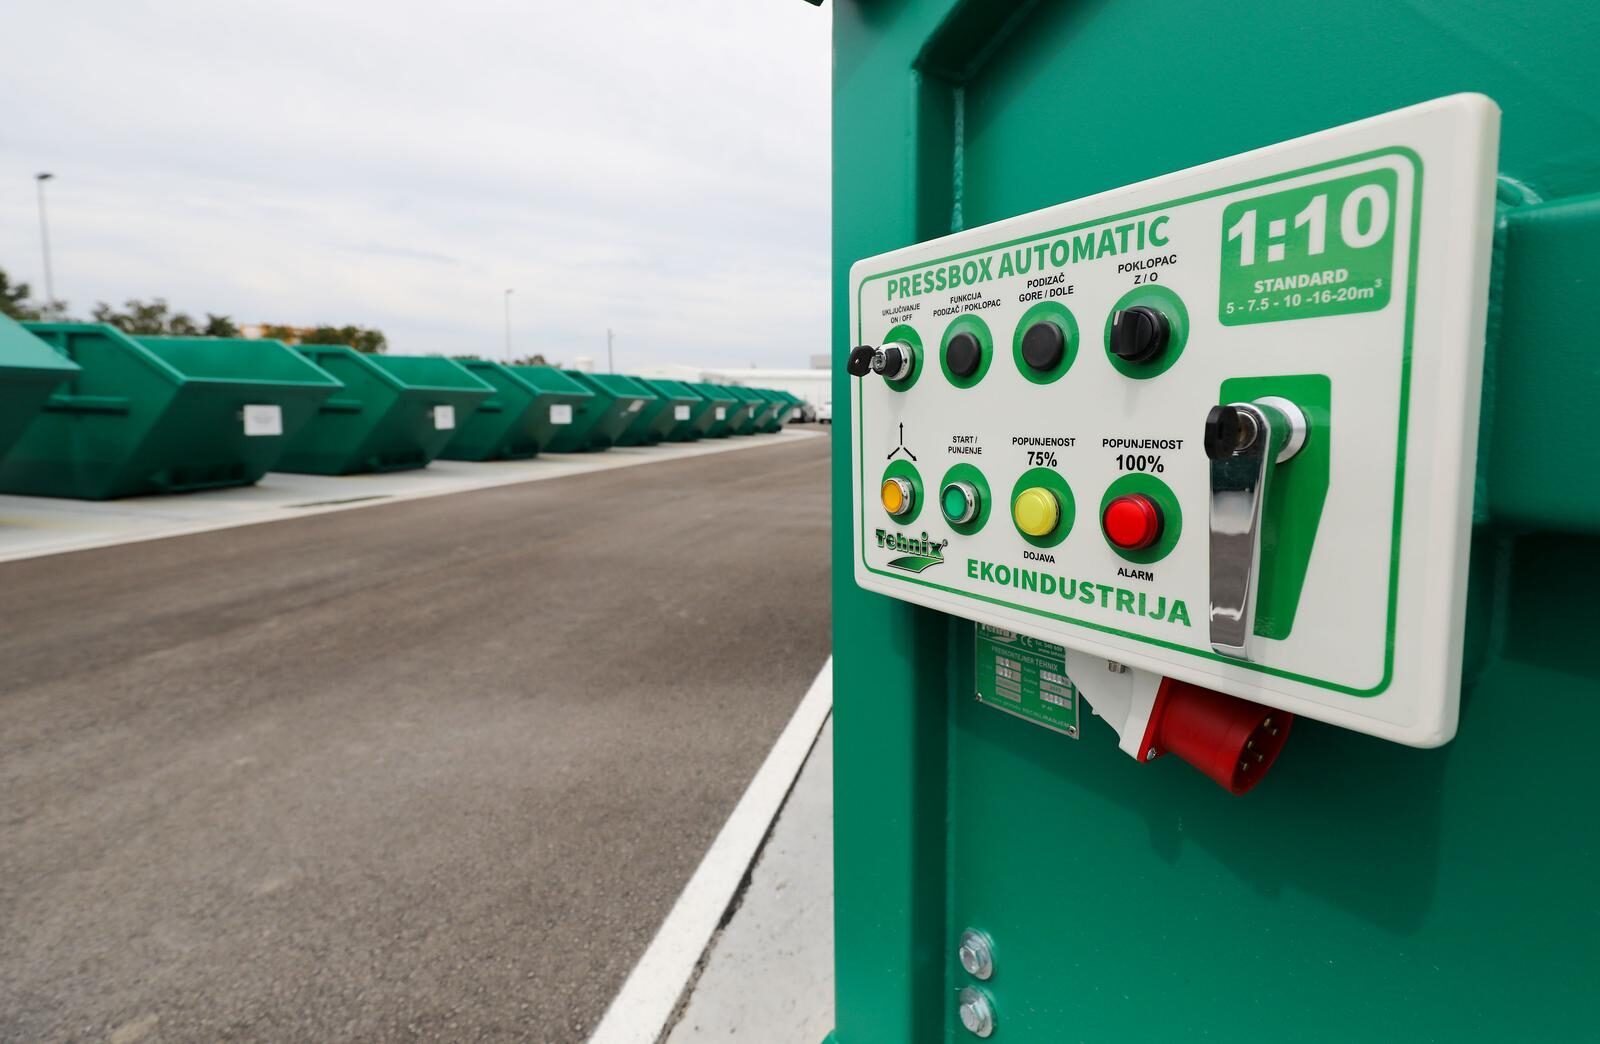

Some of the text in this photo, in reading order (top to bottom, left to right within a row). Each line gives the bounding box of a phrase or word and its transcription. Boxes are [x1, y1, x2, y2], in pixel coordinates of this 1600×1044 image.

[1228, 184, 1390, 267] 1:10
[887, 215, 1170, 301] PRESSBOX AUTOMATIC
[1118, 254, 1177, 274] POKLOPAC
[1027, 272, 1065, 289] PODIZAČ
[1134, 275, 1142, 285] Z
[1254, 268, 1349, 294] STANDARD
[950, 291, 982, 304] FUNKCIJA
[1018, 289, 1043, 303] GORE
[1049, 285, 1074, 298] DOLE
[882, 303, 921, 316] UKLJUČIVANJE
[933, 305, 960, 317] PODIZAČ
[964, 299, 1001, 312] POKLOPAC
[1226, 302, 1235, 314] 5
[1247, 298, 1270, 312] 7.5
[1284, 294, 1301, 307] 10
[890, 316, 898, 324] ON
[902, 314, 913, 322] OFF
[952, 436, 974, 444] START
[1012, 437, 1076, 447] POPUNJENOST
[1102, 438, 1184, 450] POPUNJENOST
[948, 446, 982, 455] PUNJENJE
[1027, 451, 1057, 467] 75%
[1116, 454, 1165, 473] 100%
[1023, 550, 1056, 564] DOJAVA
[1117, 567, 1154, 582] ALARM
[967, 558, 1192, 627] EKOINDUSTRIJA
